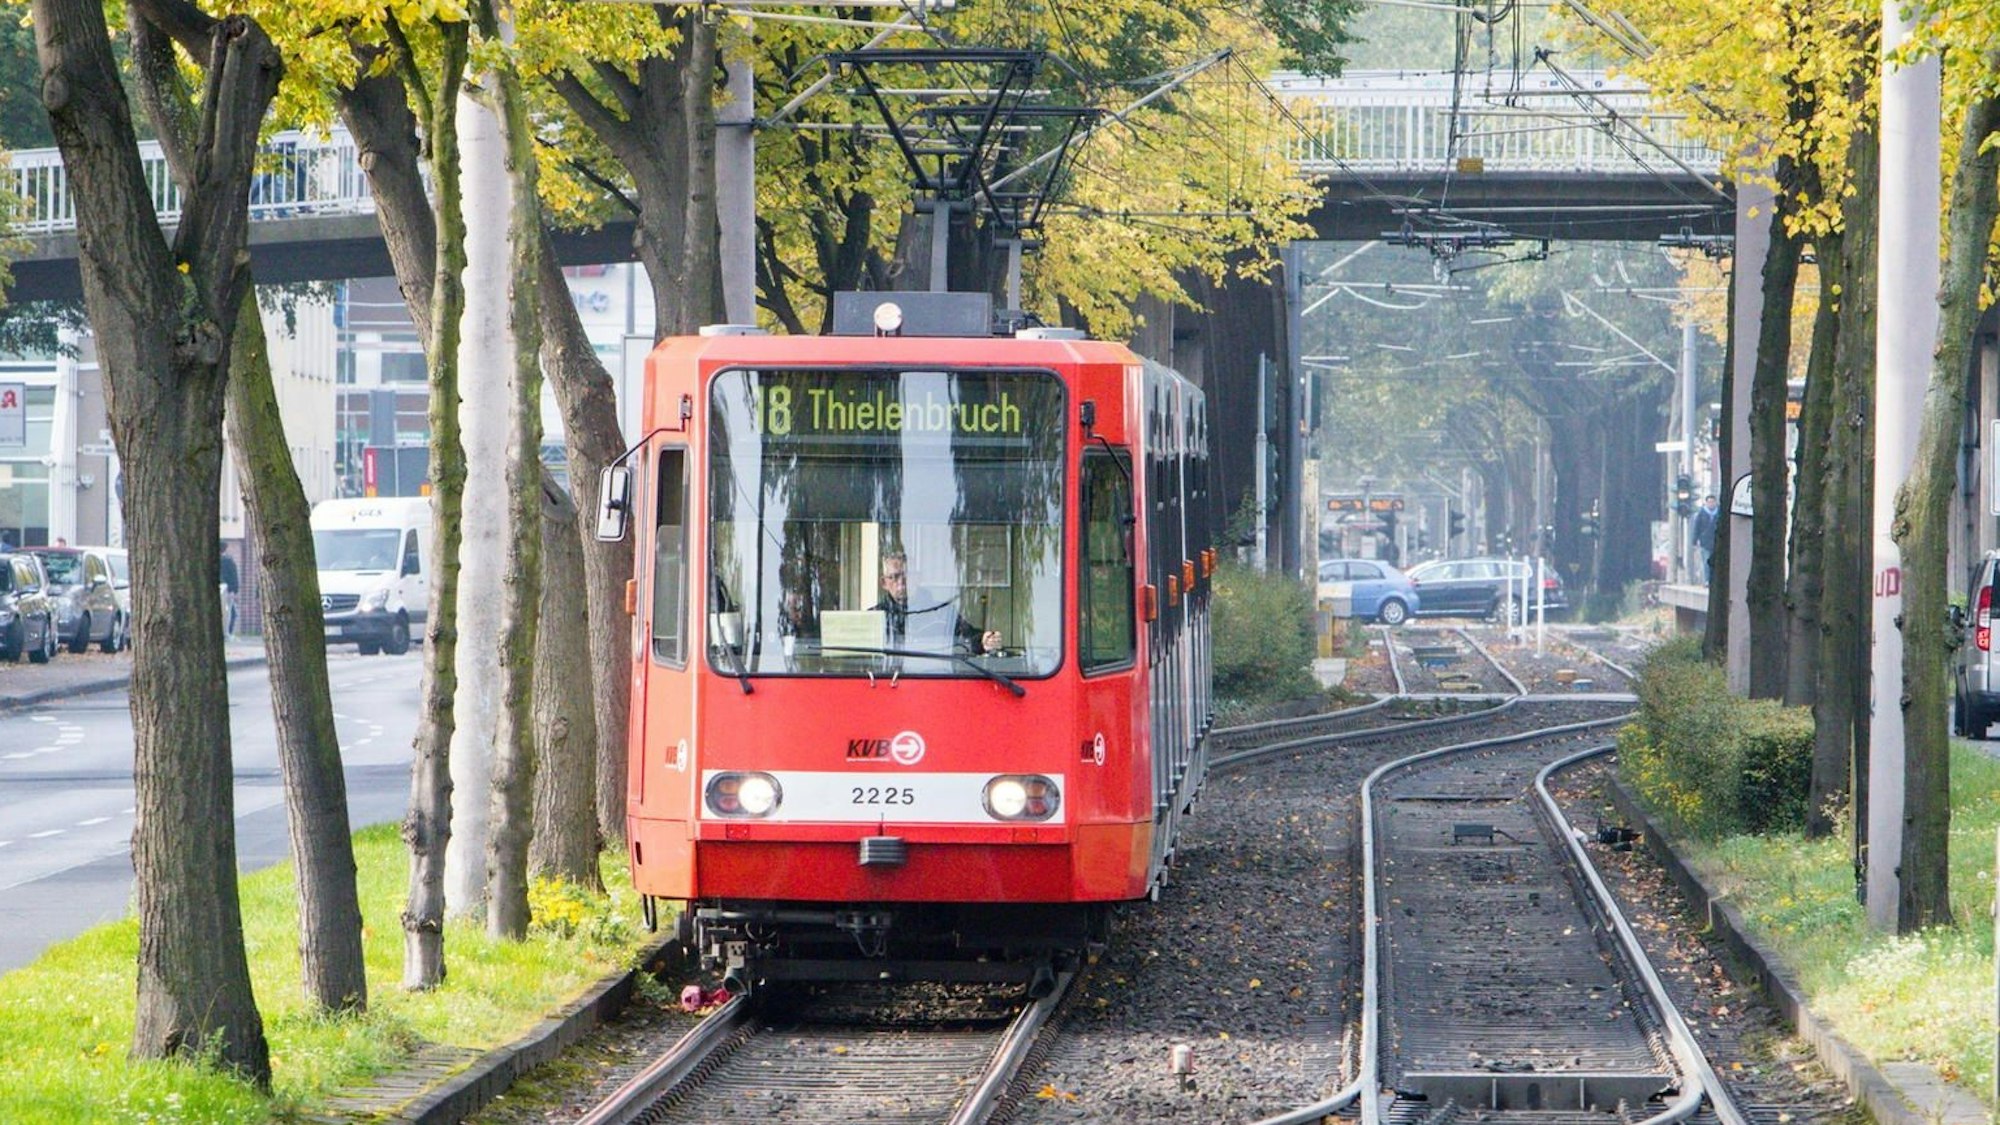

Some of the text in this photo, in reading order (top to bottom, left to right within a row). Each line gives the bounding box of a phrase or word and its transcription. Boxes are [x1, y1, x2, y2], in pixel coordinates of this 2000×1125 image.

[756, 384, 1021, 435] 18 Thielenbruch
[846, 738, 892, 758] KVB
[851, 786, 915, 806] 2225
